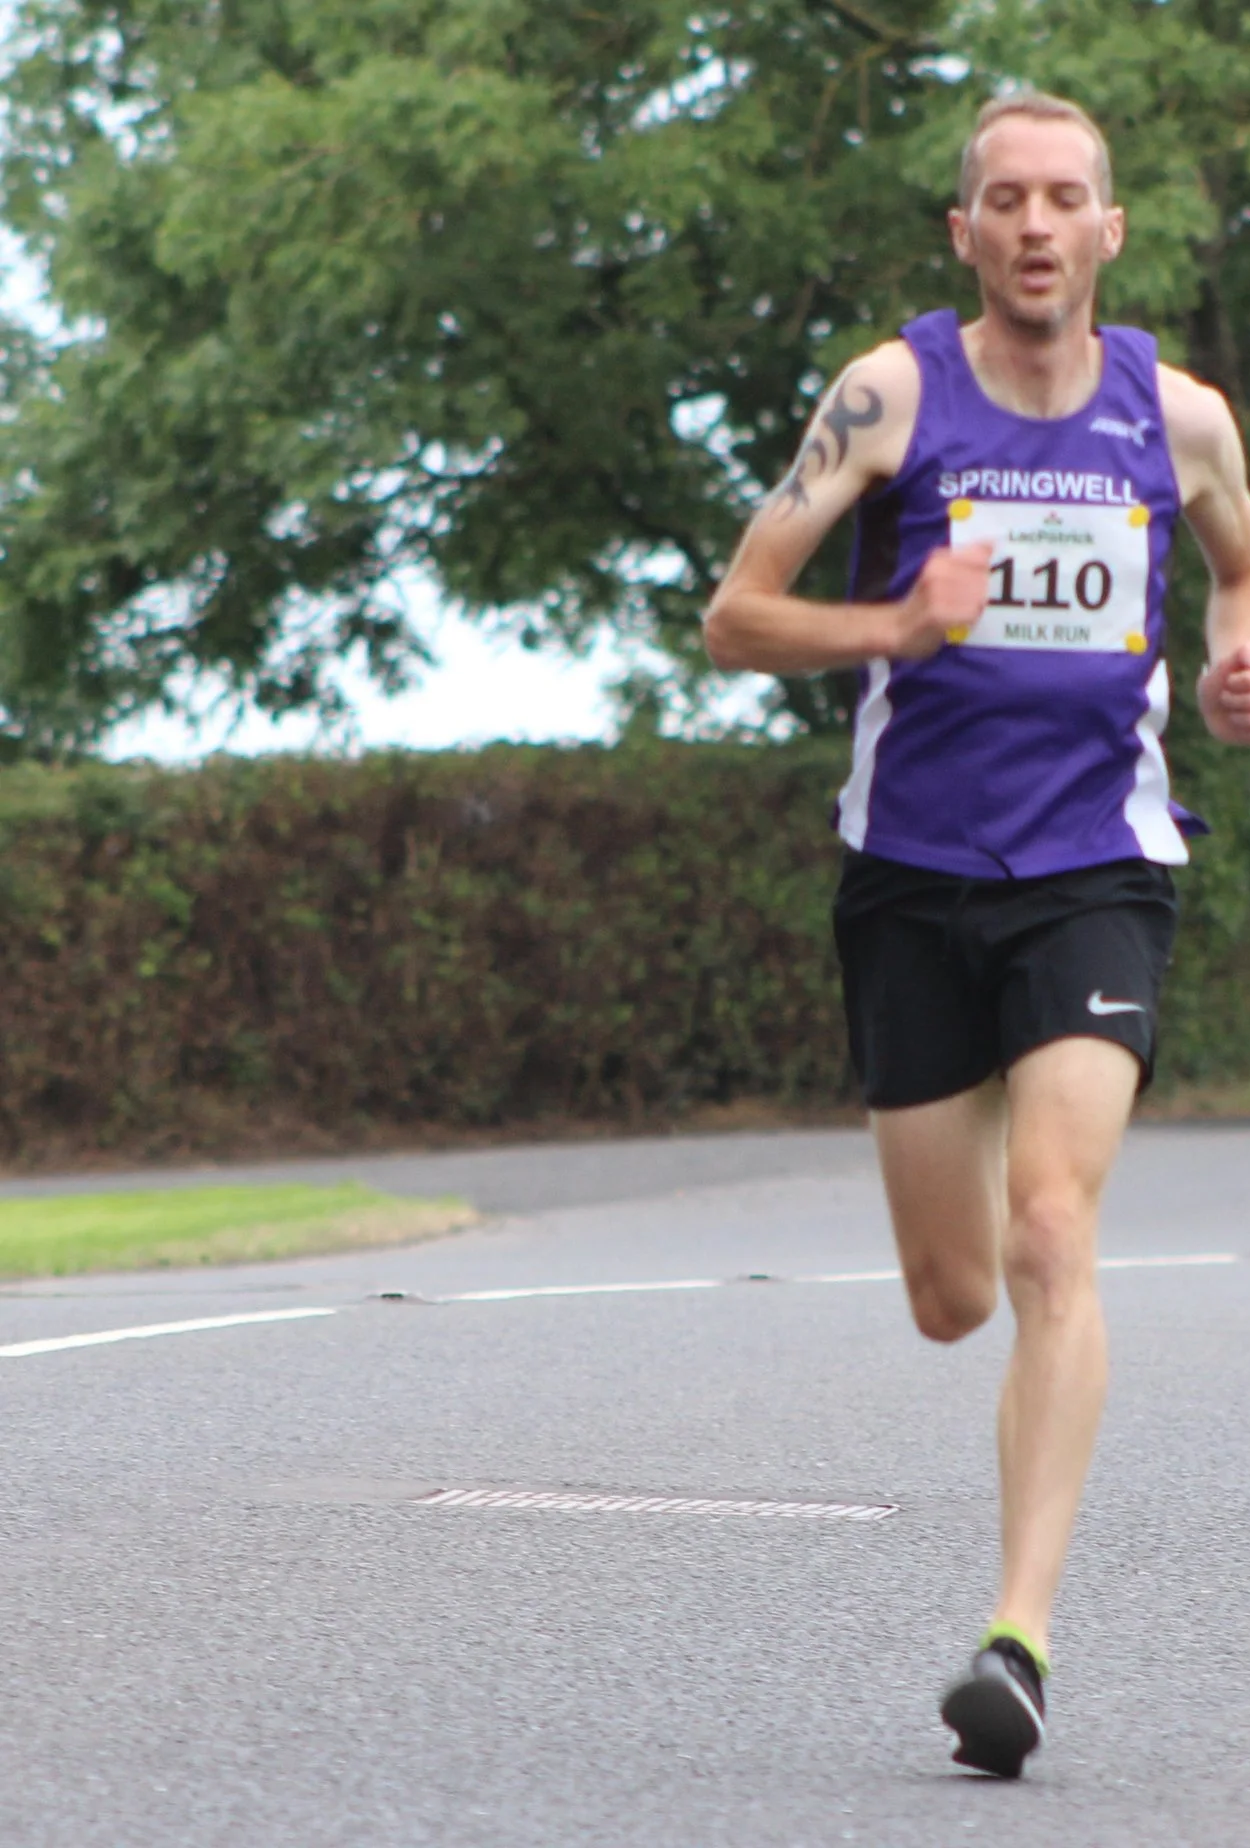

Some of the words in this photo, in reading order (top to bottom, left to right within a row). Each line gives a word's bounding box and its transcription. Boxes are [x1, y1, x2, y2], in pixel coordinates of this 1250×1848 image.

[938, 468, 1140, 504] SPRINGWELL
[987, 557, 1113, 612] 110
[1004, 624, 1047, 641] MILK
[1053, 625, 1091, 642] RUN
